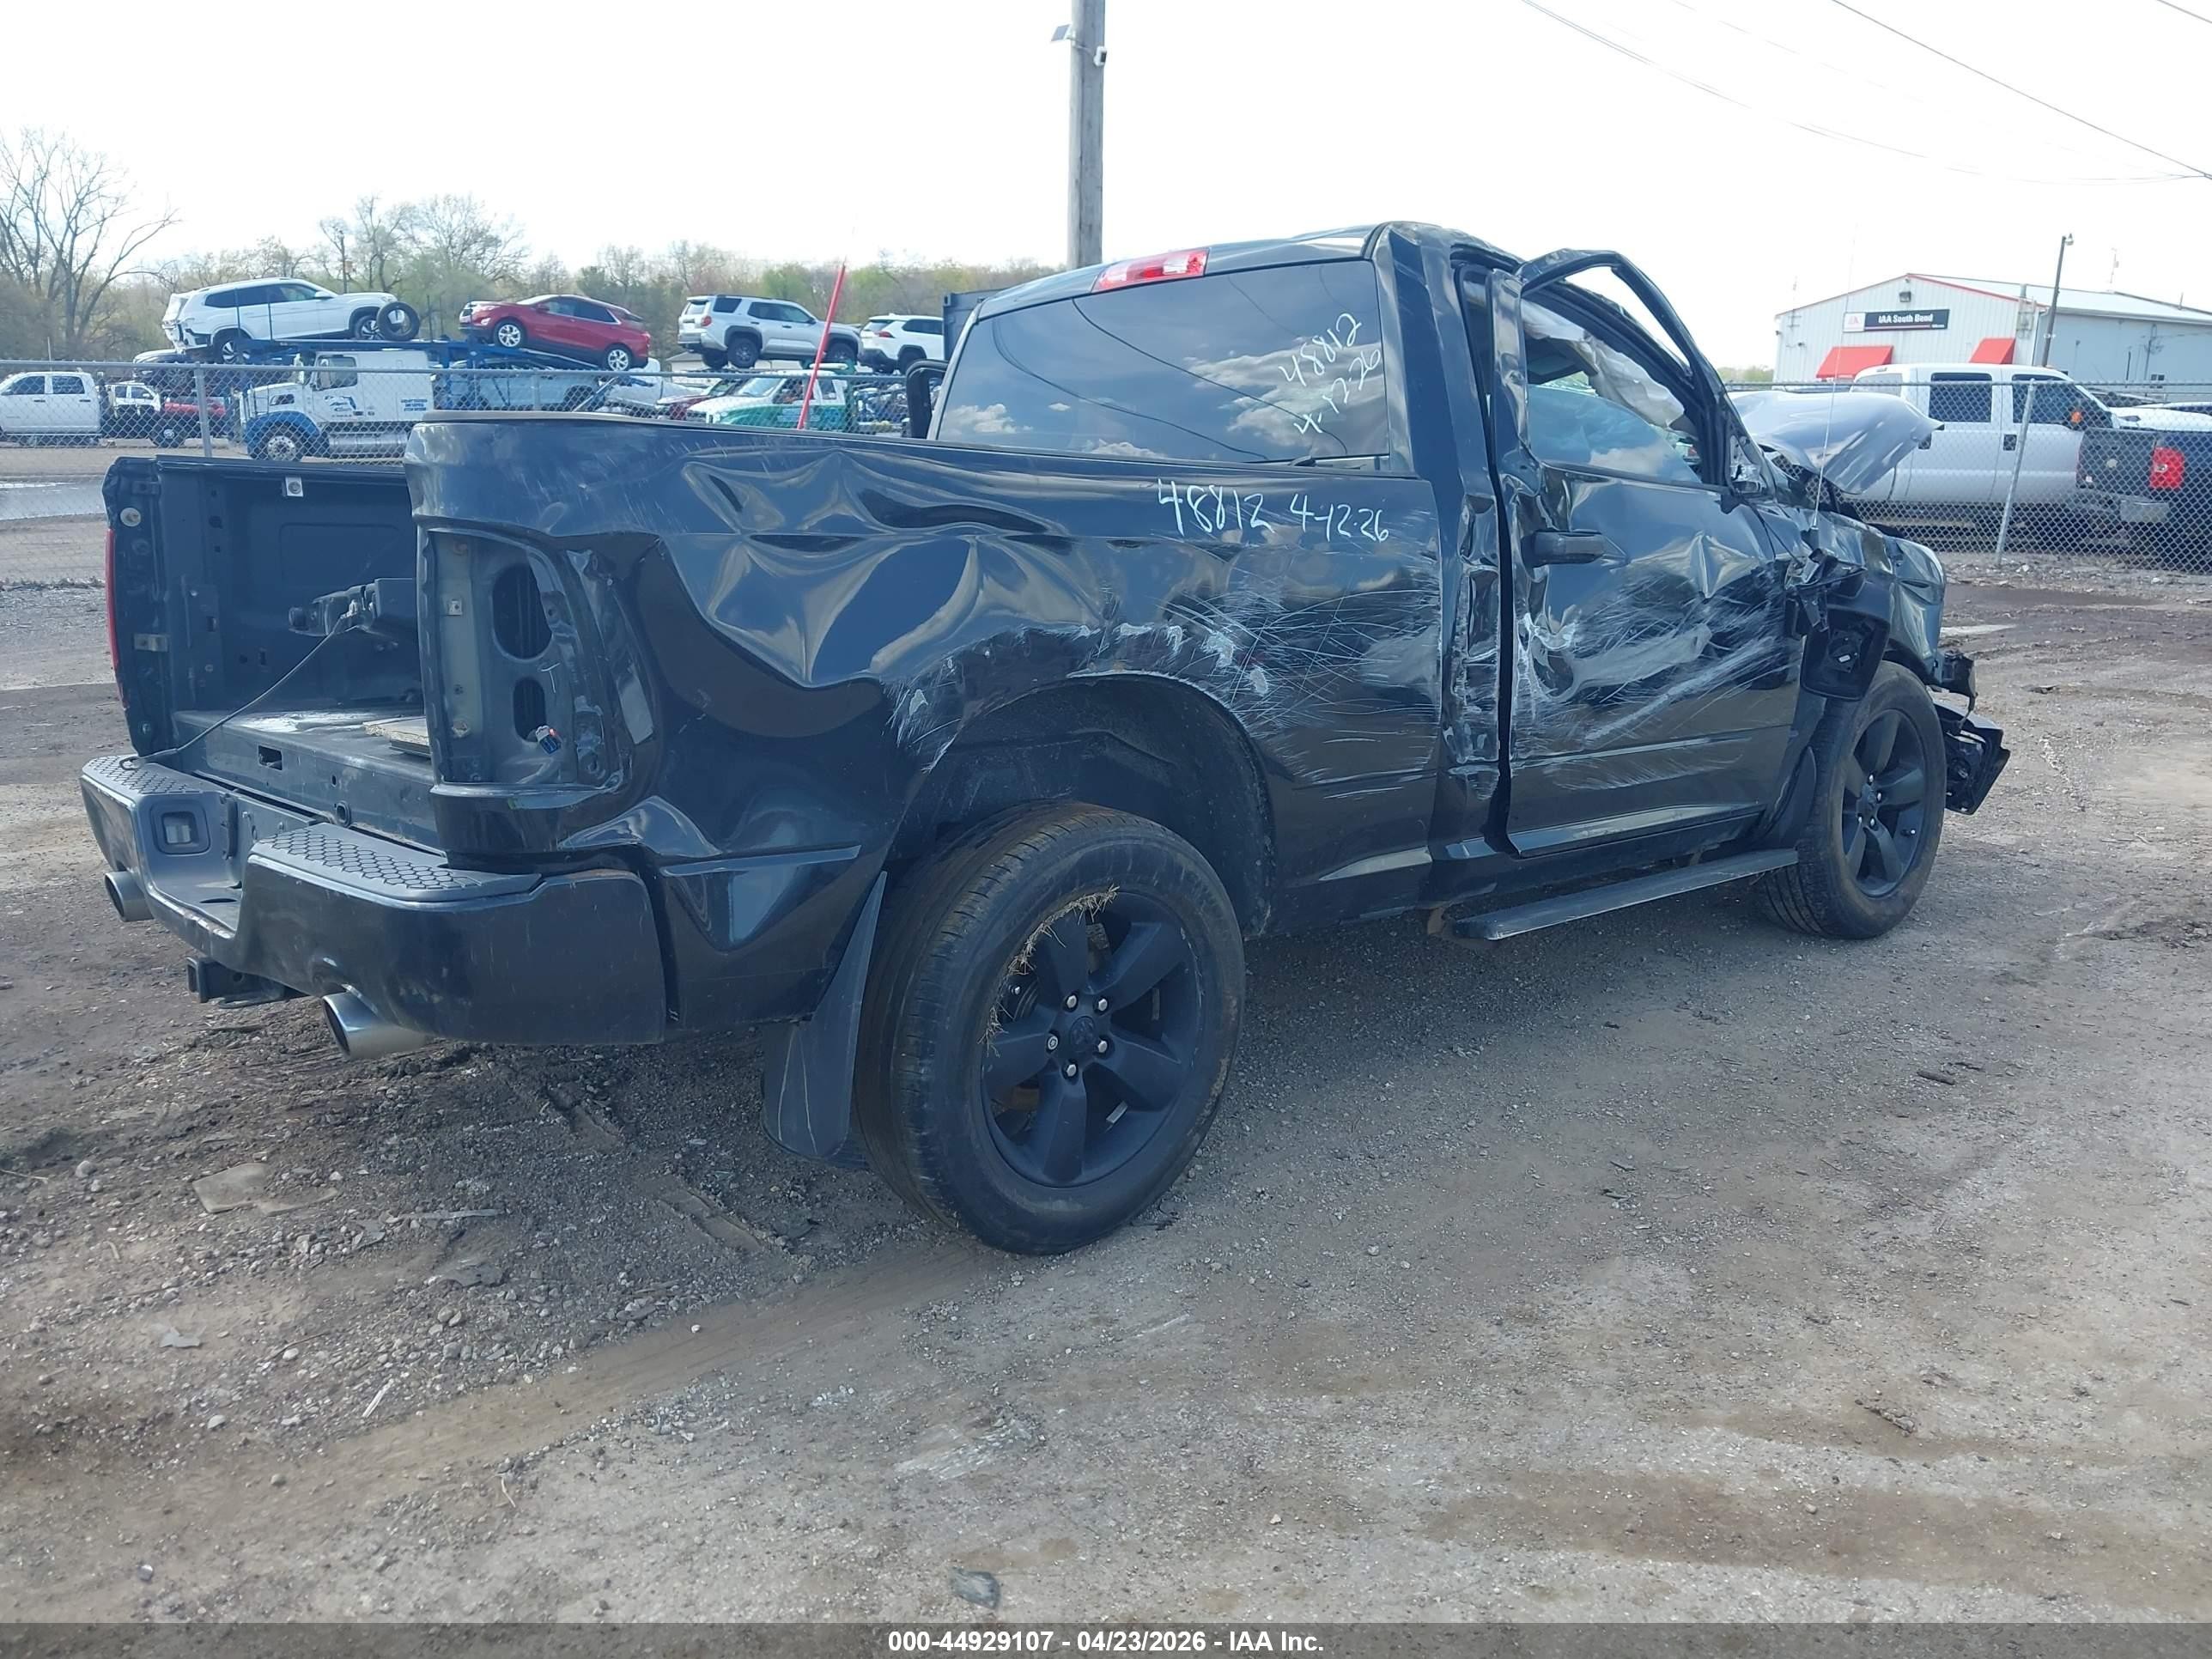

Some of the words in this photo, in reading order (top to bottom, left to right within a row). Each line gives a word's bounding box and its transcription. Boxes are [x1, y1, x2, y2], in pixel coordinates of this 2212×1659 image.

[1893, 314, 1913, 323] South
[1914, 313, 1933, 322] Bend
[1278, 313, 1362, 386] 48812
[1158, 478, 1275, 537] 48812
